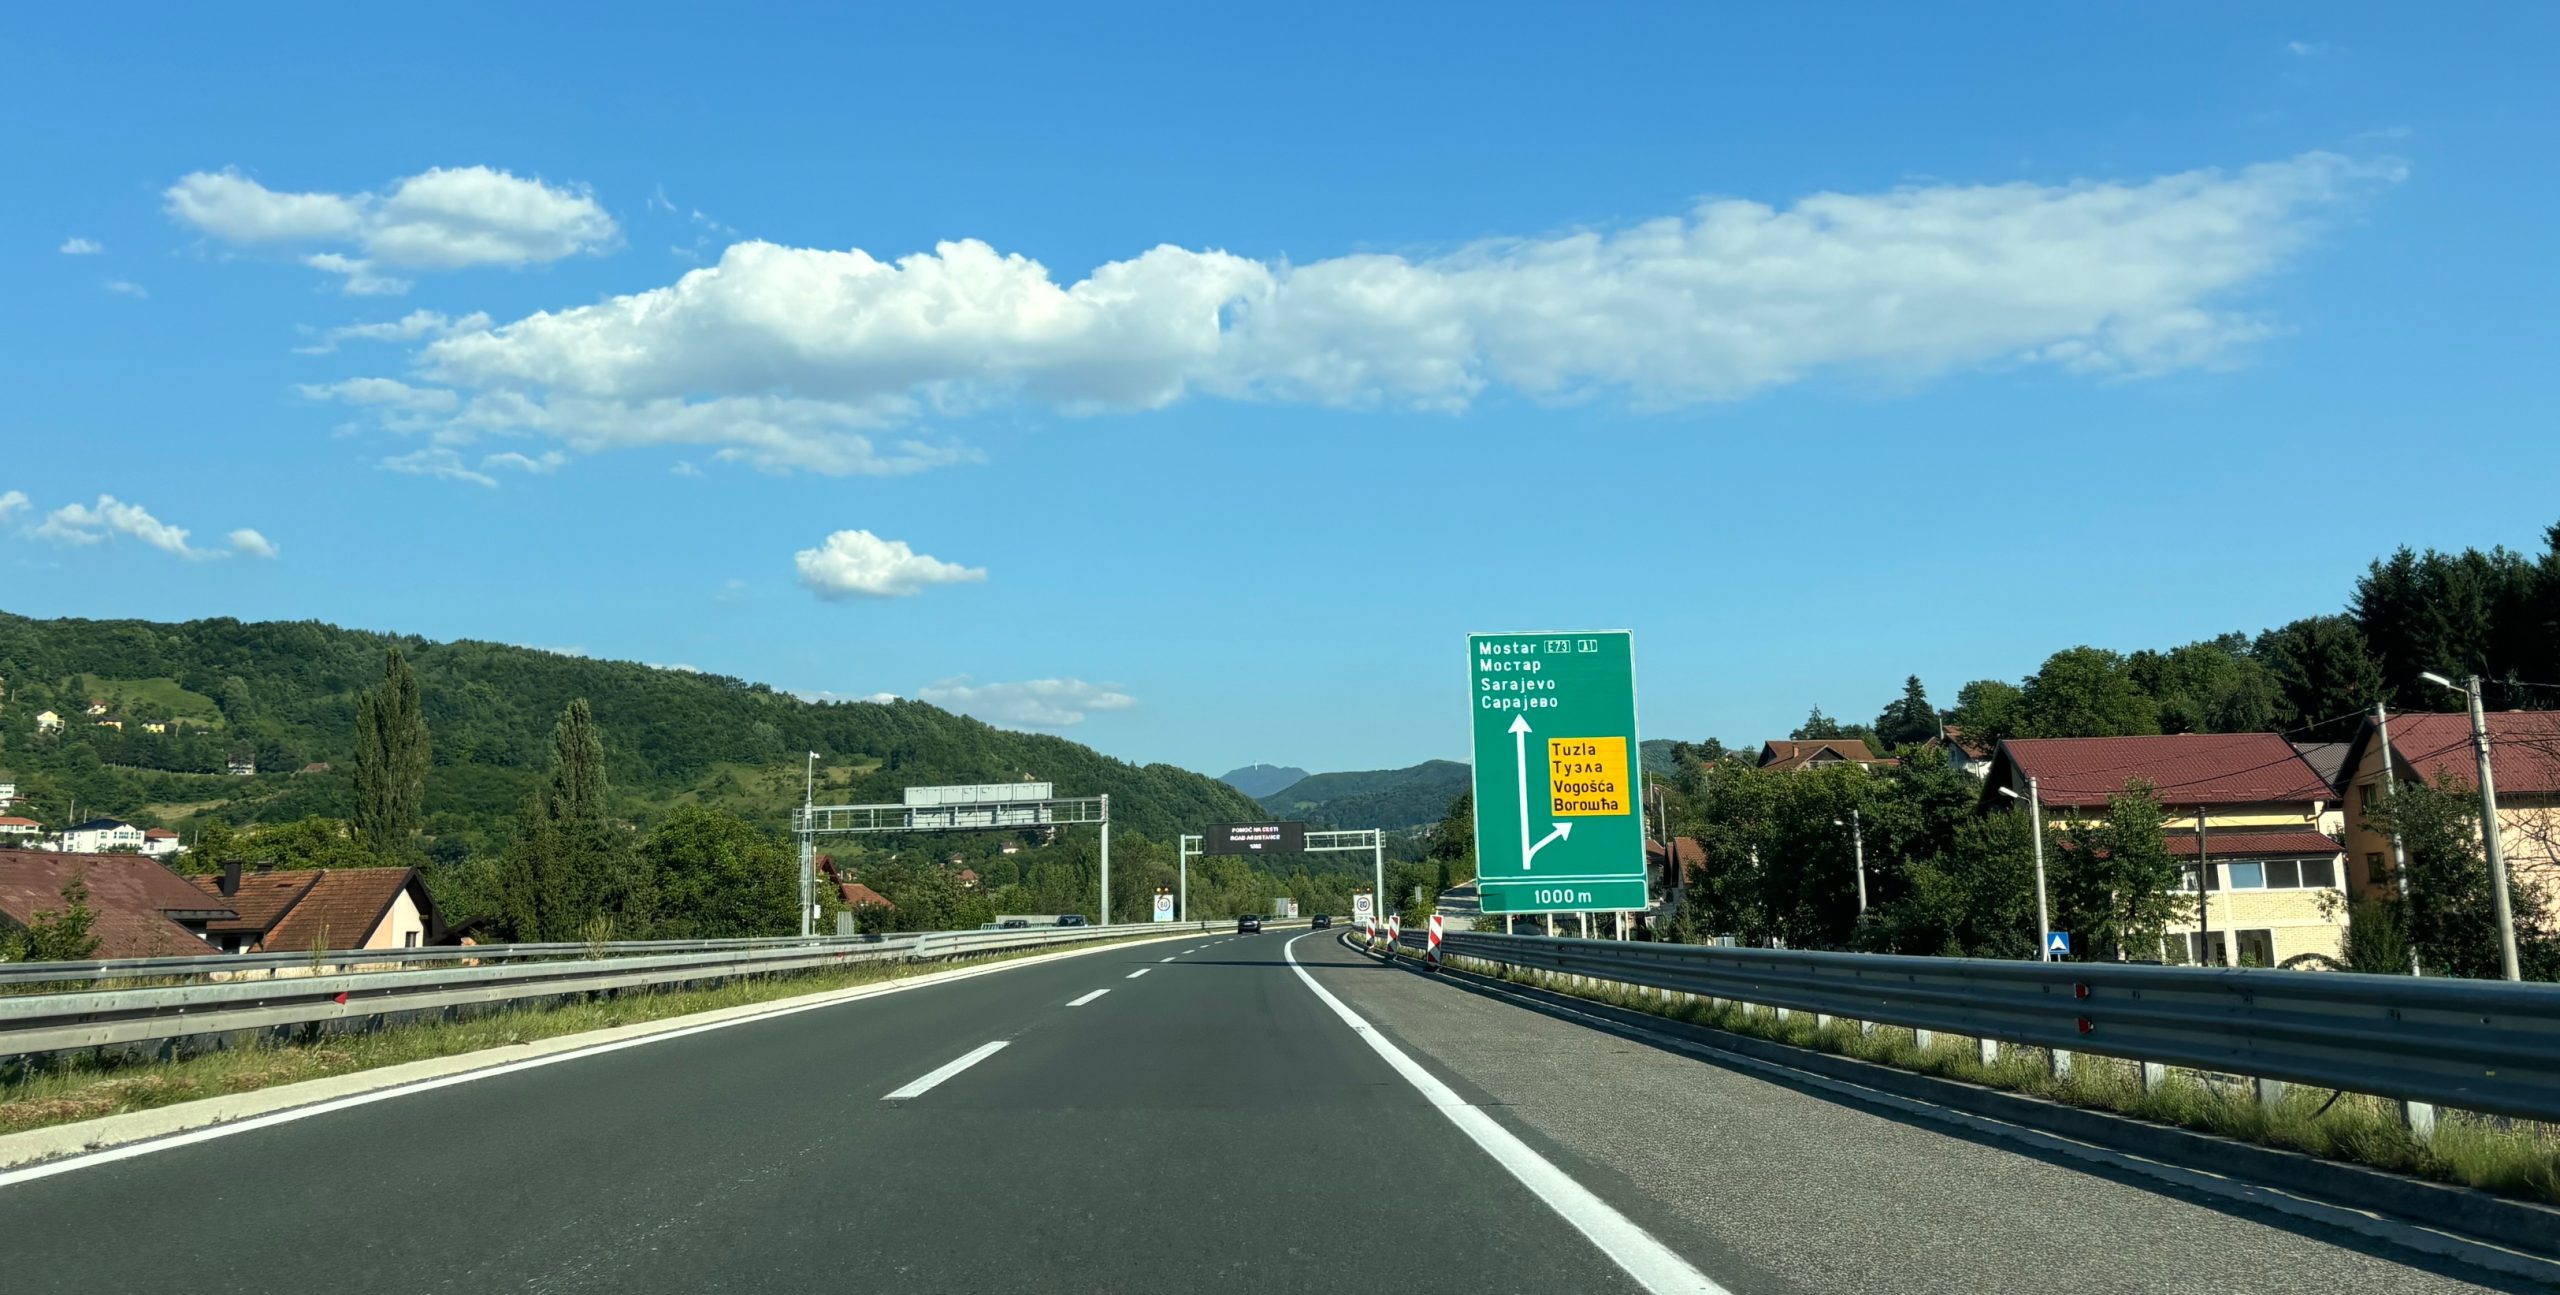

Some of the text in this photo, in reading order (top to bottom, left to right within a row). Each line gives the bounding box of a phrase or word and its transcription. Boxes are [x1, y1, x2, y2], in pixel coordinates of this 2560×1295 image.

[1479, 641, 1537, 655] Mostar
[1547, 641, 1568, 653] E73
[1480, 658, 1541, 674] Мостар
[1481, 677, 1556, 694] Sarajevo
[1481, 695, 1558, 711] Сарајево
[1551, 742, 1596, 756] Tuzla
[1552, 760, 1603, 777] Тузла
[1553, 779, 1614, 796] Vogošća
[1554, 797, 1619, 812] Вогошћа
[1534, 888, 1592, 904] 1000 m
